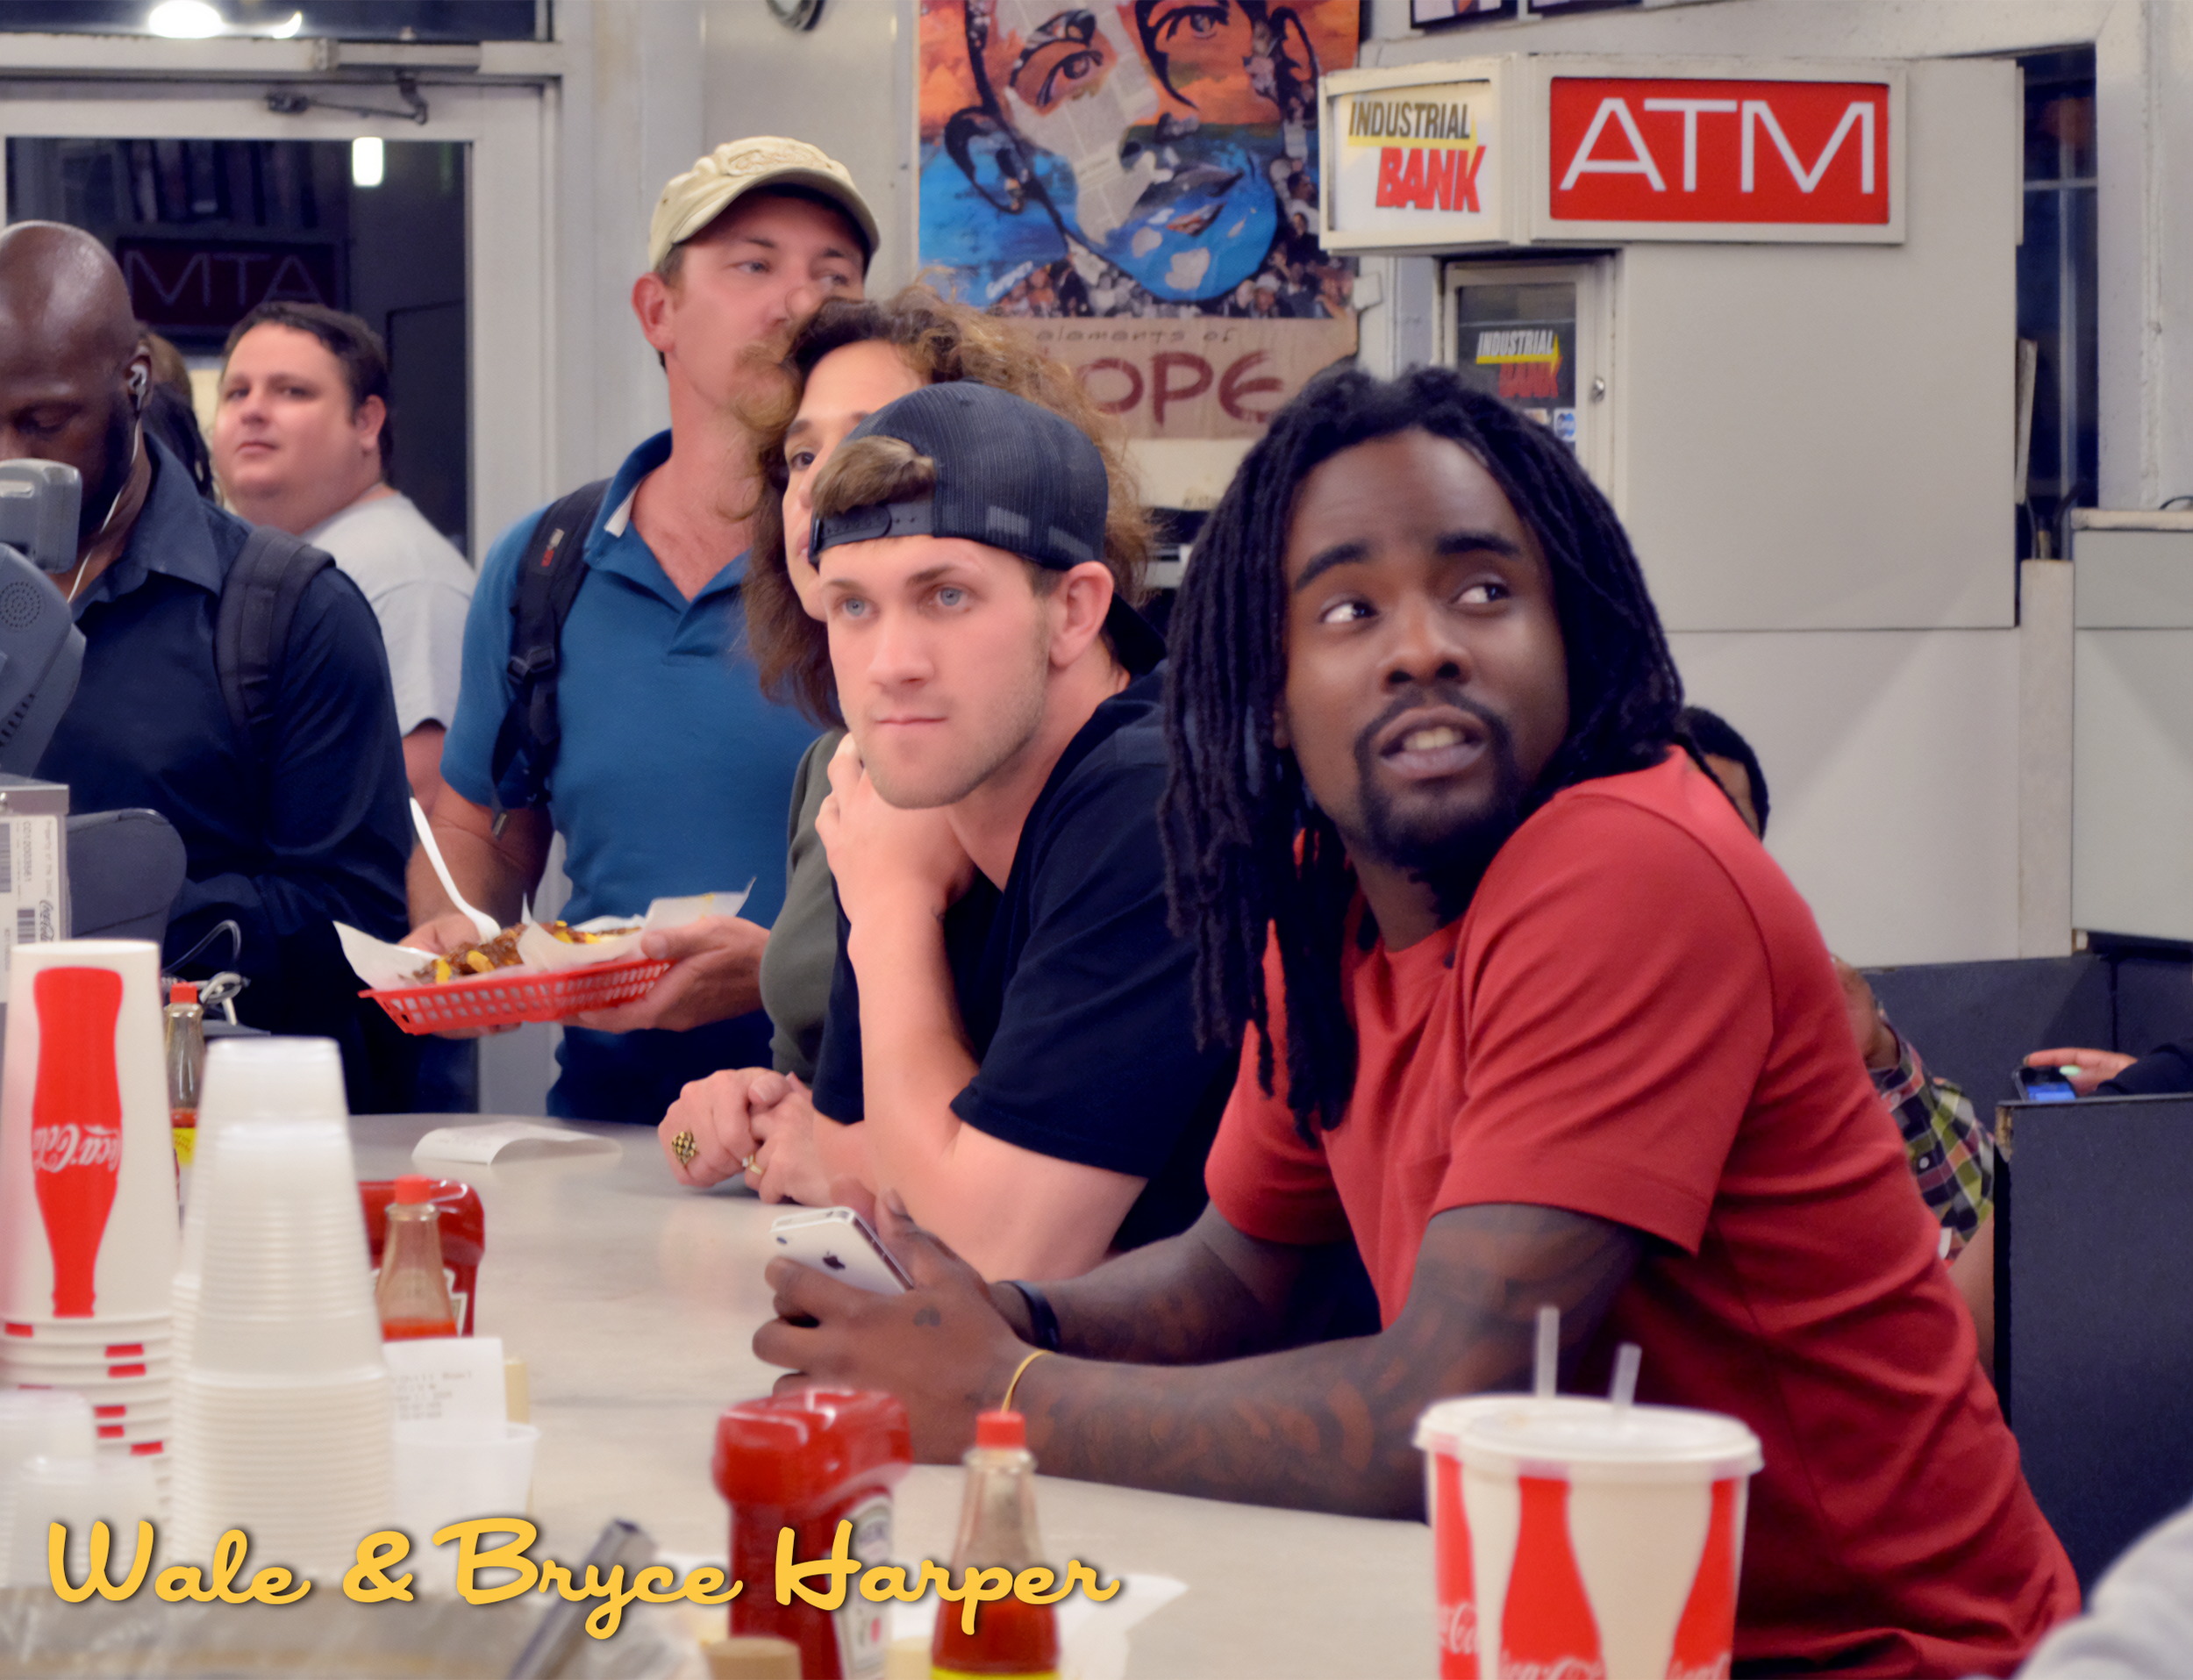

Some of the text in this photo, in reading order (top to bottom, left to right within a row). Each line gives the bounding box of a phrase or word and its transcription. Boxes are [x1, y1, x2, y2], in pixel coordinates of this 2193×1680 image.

[1348, 101, 1470, 139] INDUSTRIAL
[1559, 97, 1875, 194] ATM
[1375, 145, 1487, 212] BANK
[1203, 326, 1240, 343] of
[1475, 329, 1554, 357] INDUSTRIAL
[1044, 347, 1284, 427] OPE
[1498, 355, 1563, 398] BANK
